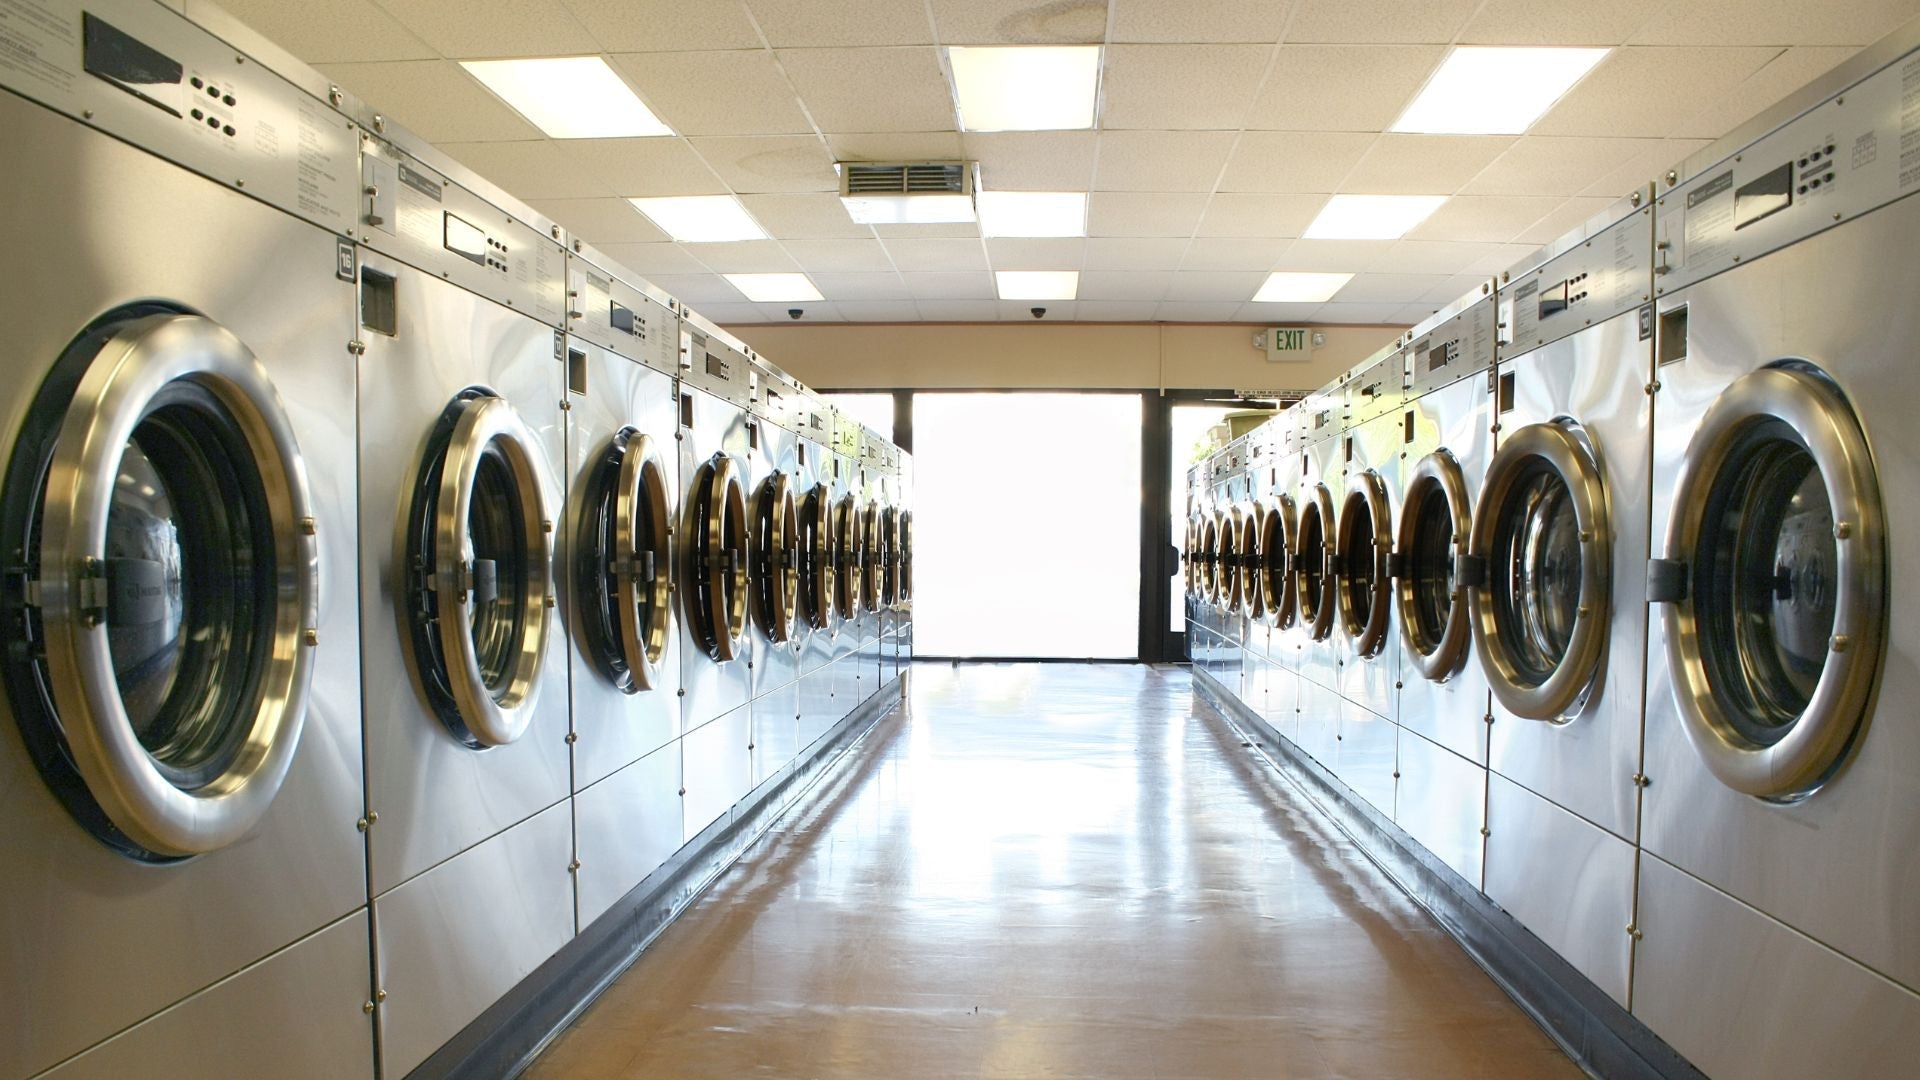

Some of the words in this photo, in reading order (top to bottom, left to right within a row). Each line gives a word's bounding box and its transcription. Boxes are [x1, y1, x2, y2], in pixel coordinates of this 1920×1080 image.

[342, 252, 351, 268] 16
[1642, 316, 1649, 329] 10
[1276, 330, 1305, 350] EXIT
